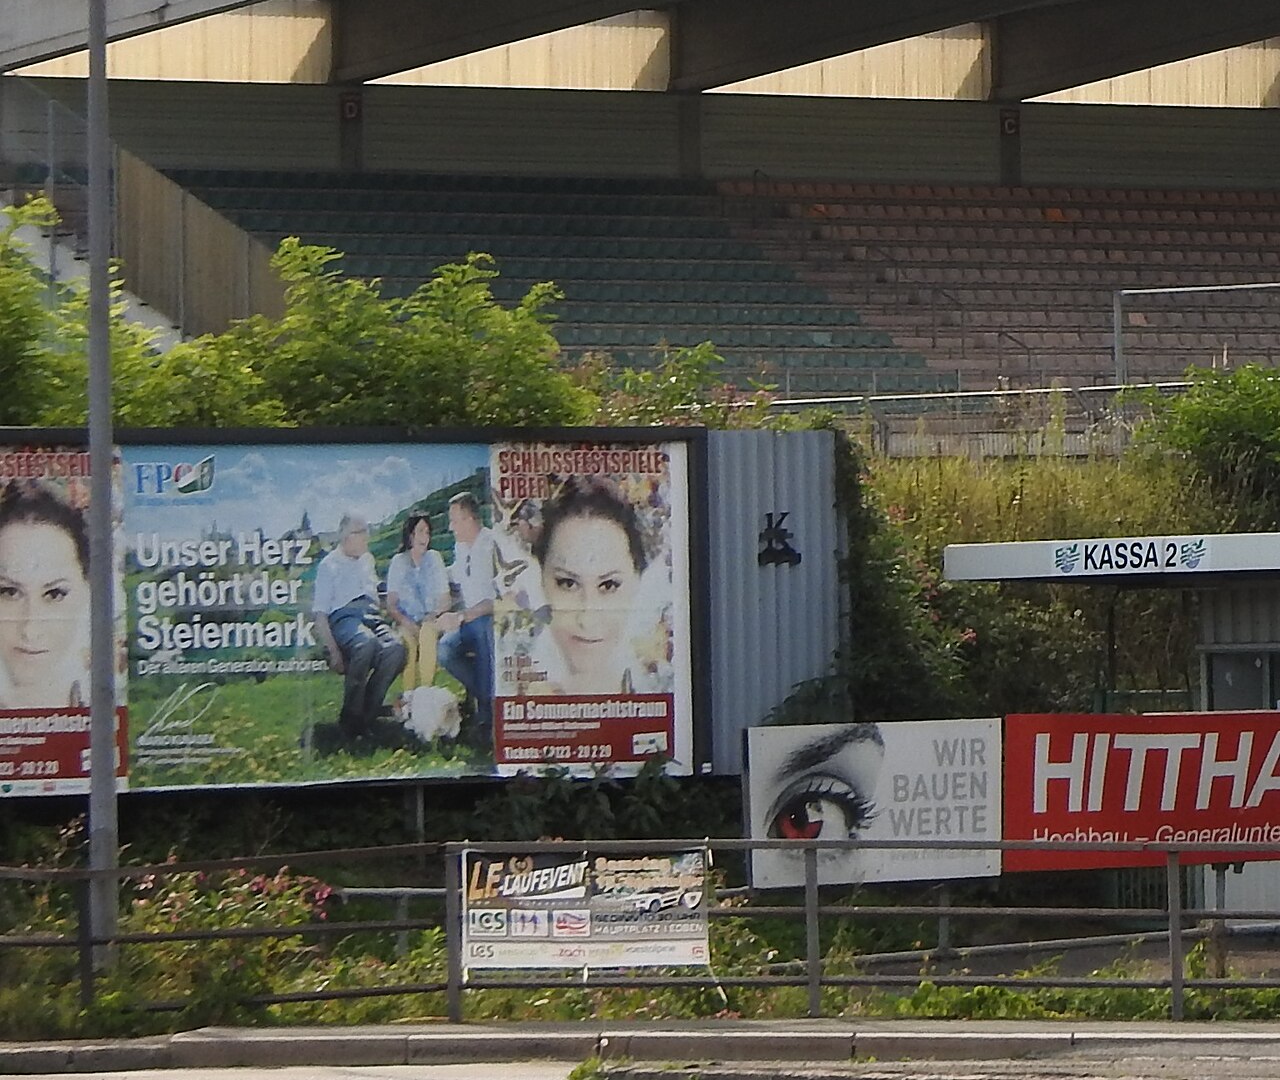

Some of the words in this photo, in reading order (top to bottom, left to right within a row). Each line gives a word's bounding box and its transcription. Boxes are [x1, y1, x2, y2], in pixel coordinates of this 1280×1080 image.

[499, 451, 664, 474] SCHLOSSFESTSPIELE
[137, 532, 232, 567] Unser
[238, 531, 313, 566] Herz
[1084, 542, 1159, 570] KASSA
[1165, 542, 1177, 568] 2
[137, 571, 244, 614] gehört
[250, 571, 302, 605] der
[137, 613, 317, 650] Steiermark
[503, 701, 525, 720] Ein
[933, 738, 987, 767] WIR
[893, 772, 988, 803] BAUEN
[889, 805, 988, 837] WERTE
